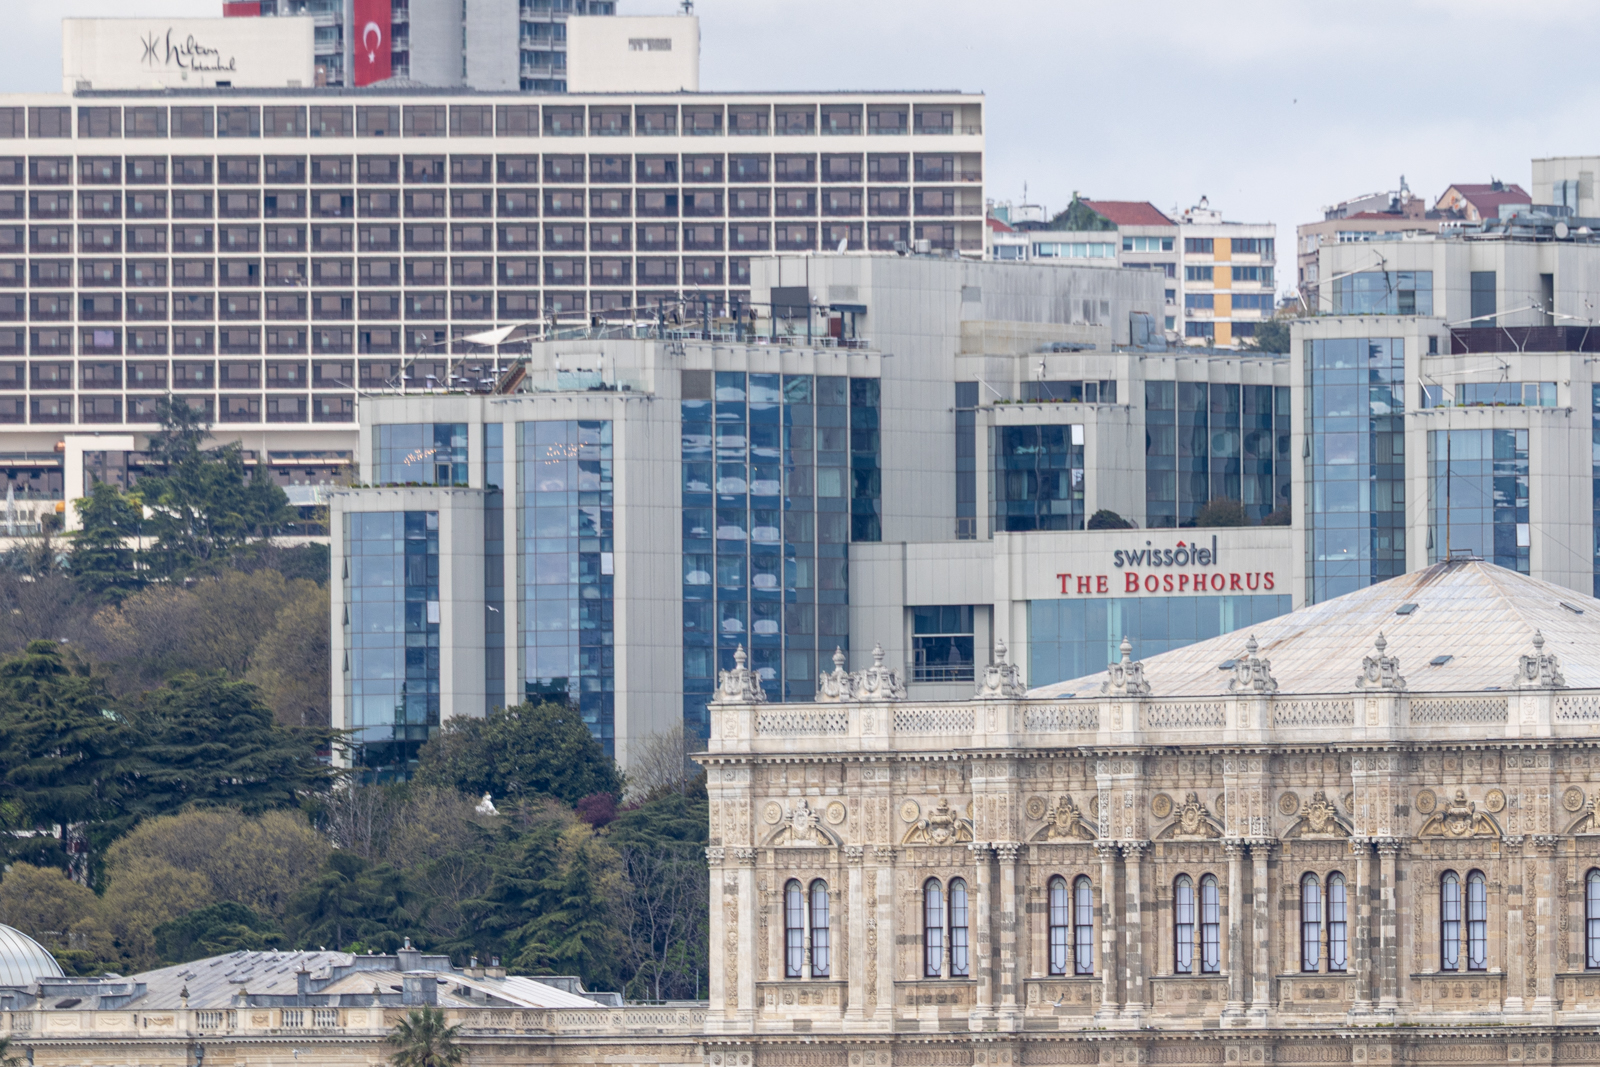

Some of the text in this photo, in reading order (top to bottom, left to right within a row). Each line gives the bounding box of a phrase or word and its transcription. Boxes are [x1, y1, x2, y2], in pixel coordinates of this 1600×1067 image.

[1113, 535, 1217, 568] swissôtel
[1056, 571, 1275, 594] THE BOSPHORUS
